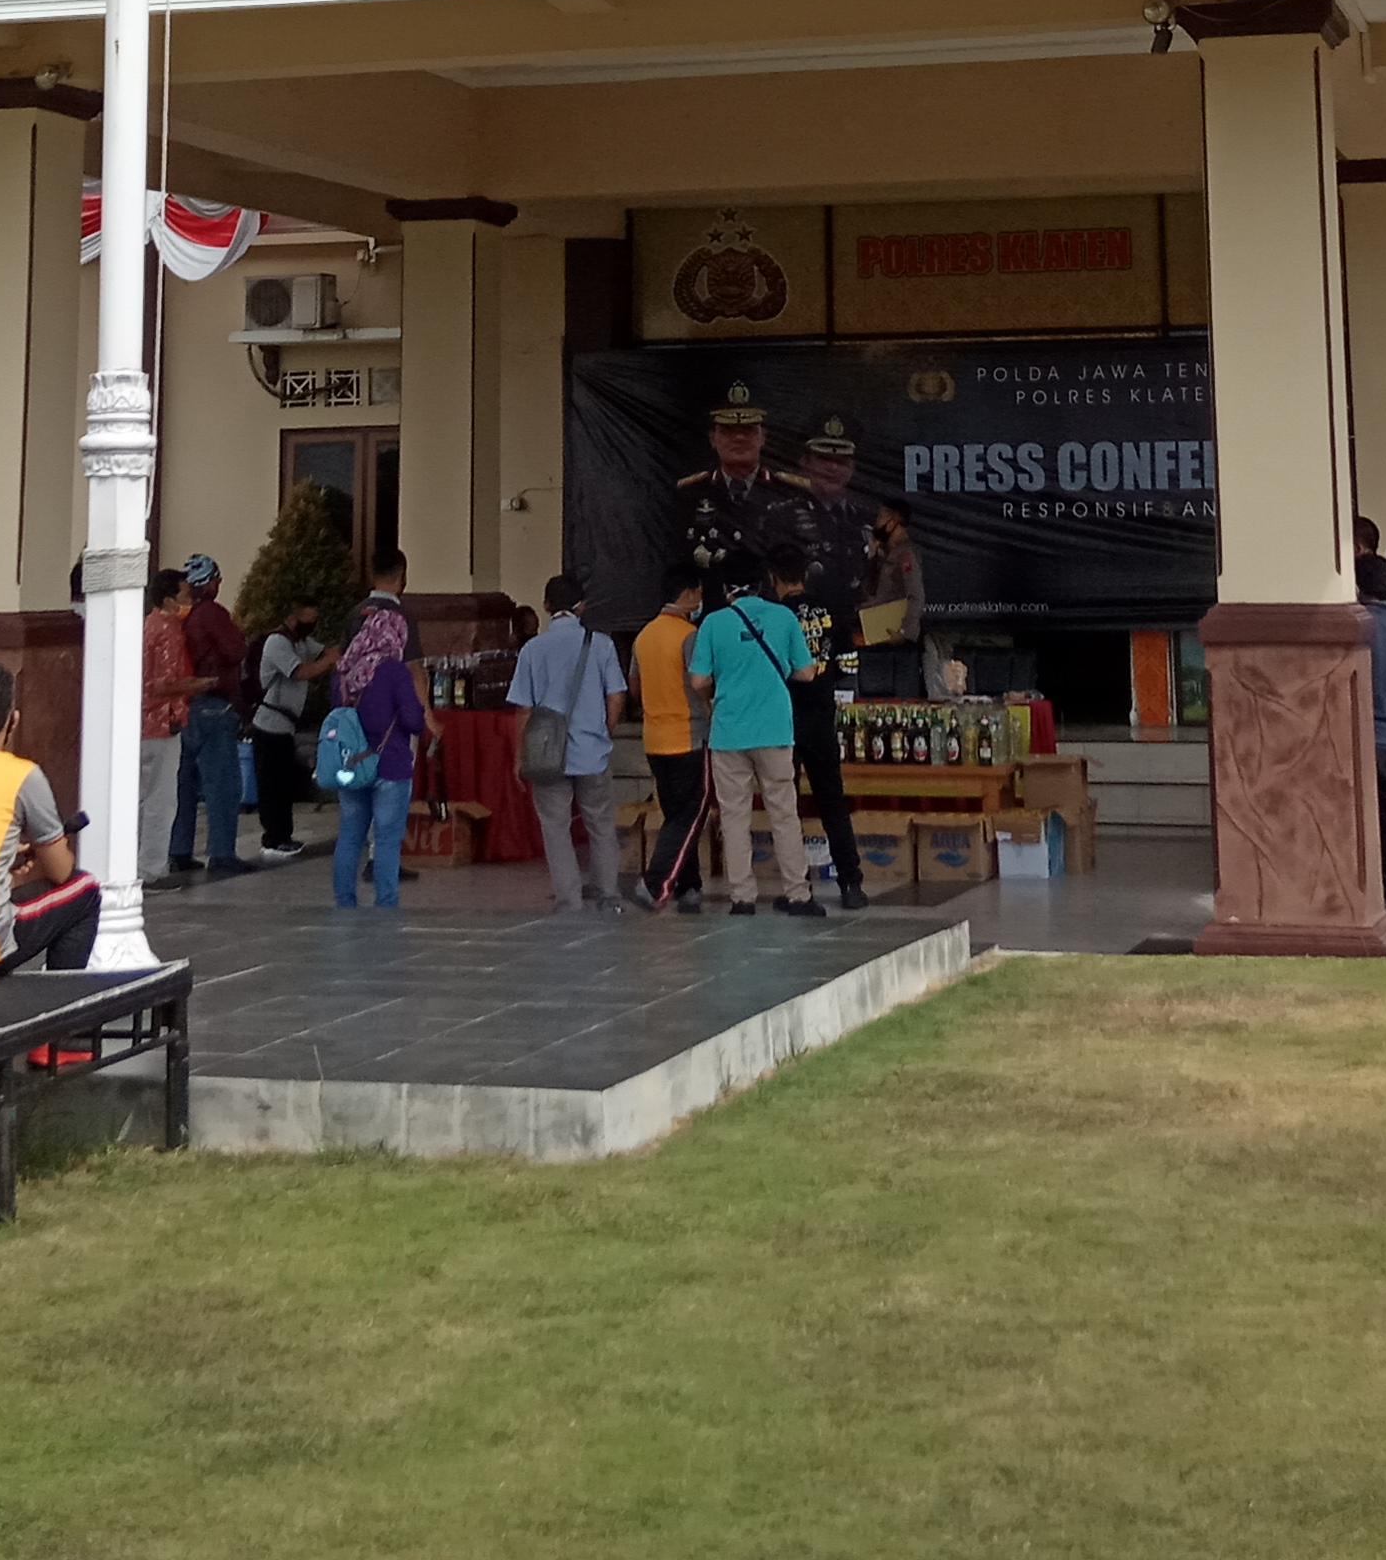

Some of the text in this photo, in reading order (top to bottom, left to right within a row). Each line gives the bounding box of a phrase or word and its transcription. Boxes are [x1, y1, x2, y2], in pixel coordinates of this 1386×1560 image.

[858, 227, 1131, 279] POLRES KLATEN
[976, 362, 1209, 382] POLDA JAWA TEN
[1016, 388, 1112, 405] POLRES
[904, 442, 1046, 492] PRESS
[1003, 501, 1153, 518] RESPONSIF
